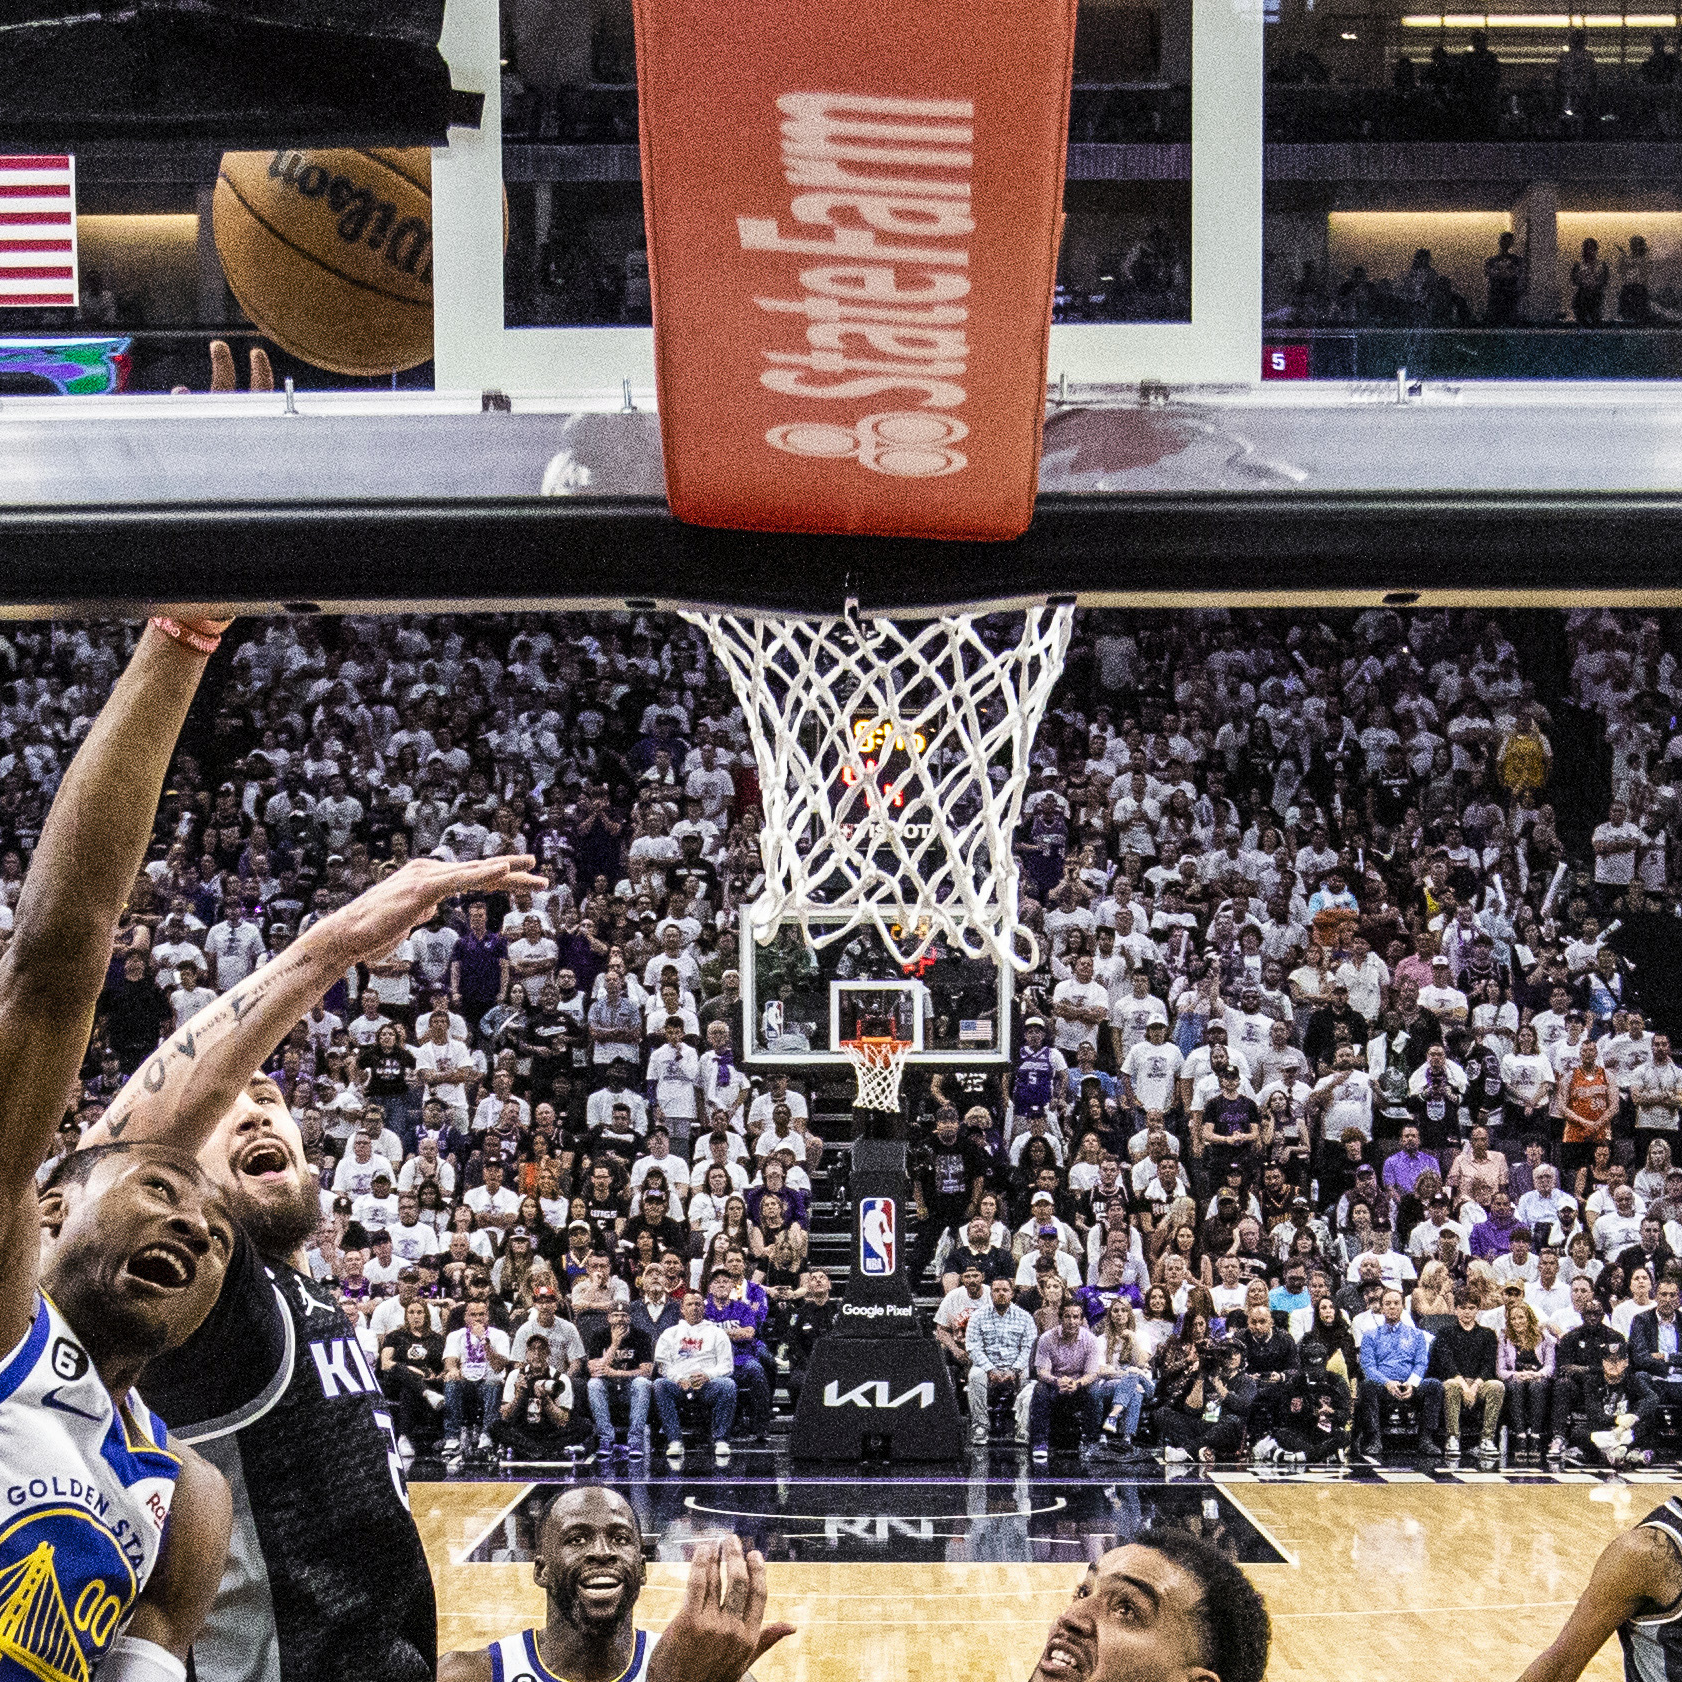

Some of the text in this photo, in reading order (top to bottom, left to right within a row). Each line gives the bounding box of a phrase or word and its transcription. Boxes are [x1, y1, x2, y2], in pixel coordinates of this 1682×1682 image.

[843, 1304, 912, 1318] Google Pixel
[55, 1343, 78, 1377] 6
[7, 1477, 110, 1517] GOLDEN
[74, 1580, 121, 1647] 00
